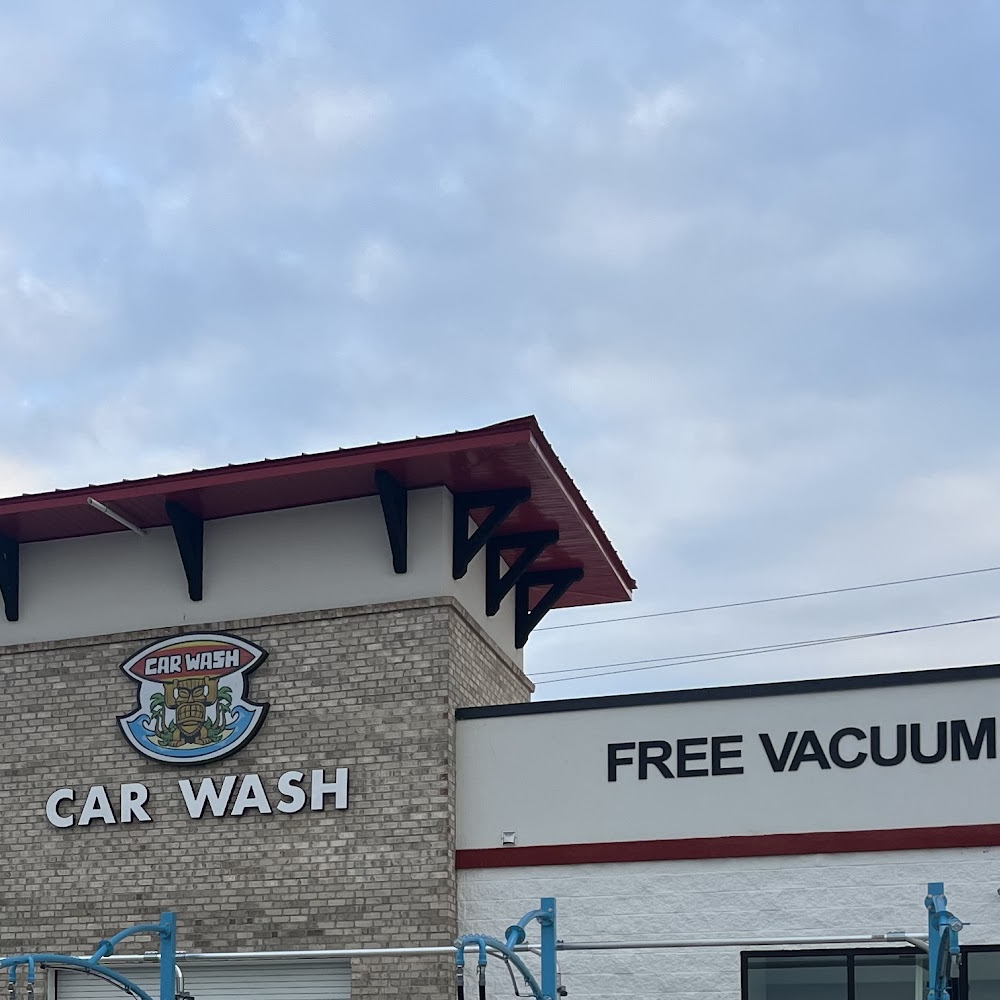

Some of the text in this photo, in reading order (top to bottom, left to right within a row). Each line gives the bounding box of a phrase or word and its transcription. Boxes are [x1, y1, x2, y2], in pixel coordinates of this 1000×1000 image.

[145, 649, 240, 676] CAR WASH
[607, 717, 997, 782] FREE VACUUM
[45, 767, 350, 829] CAR WASH
